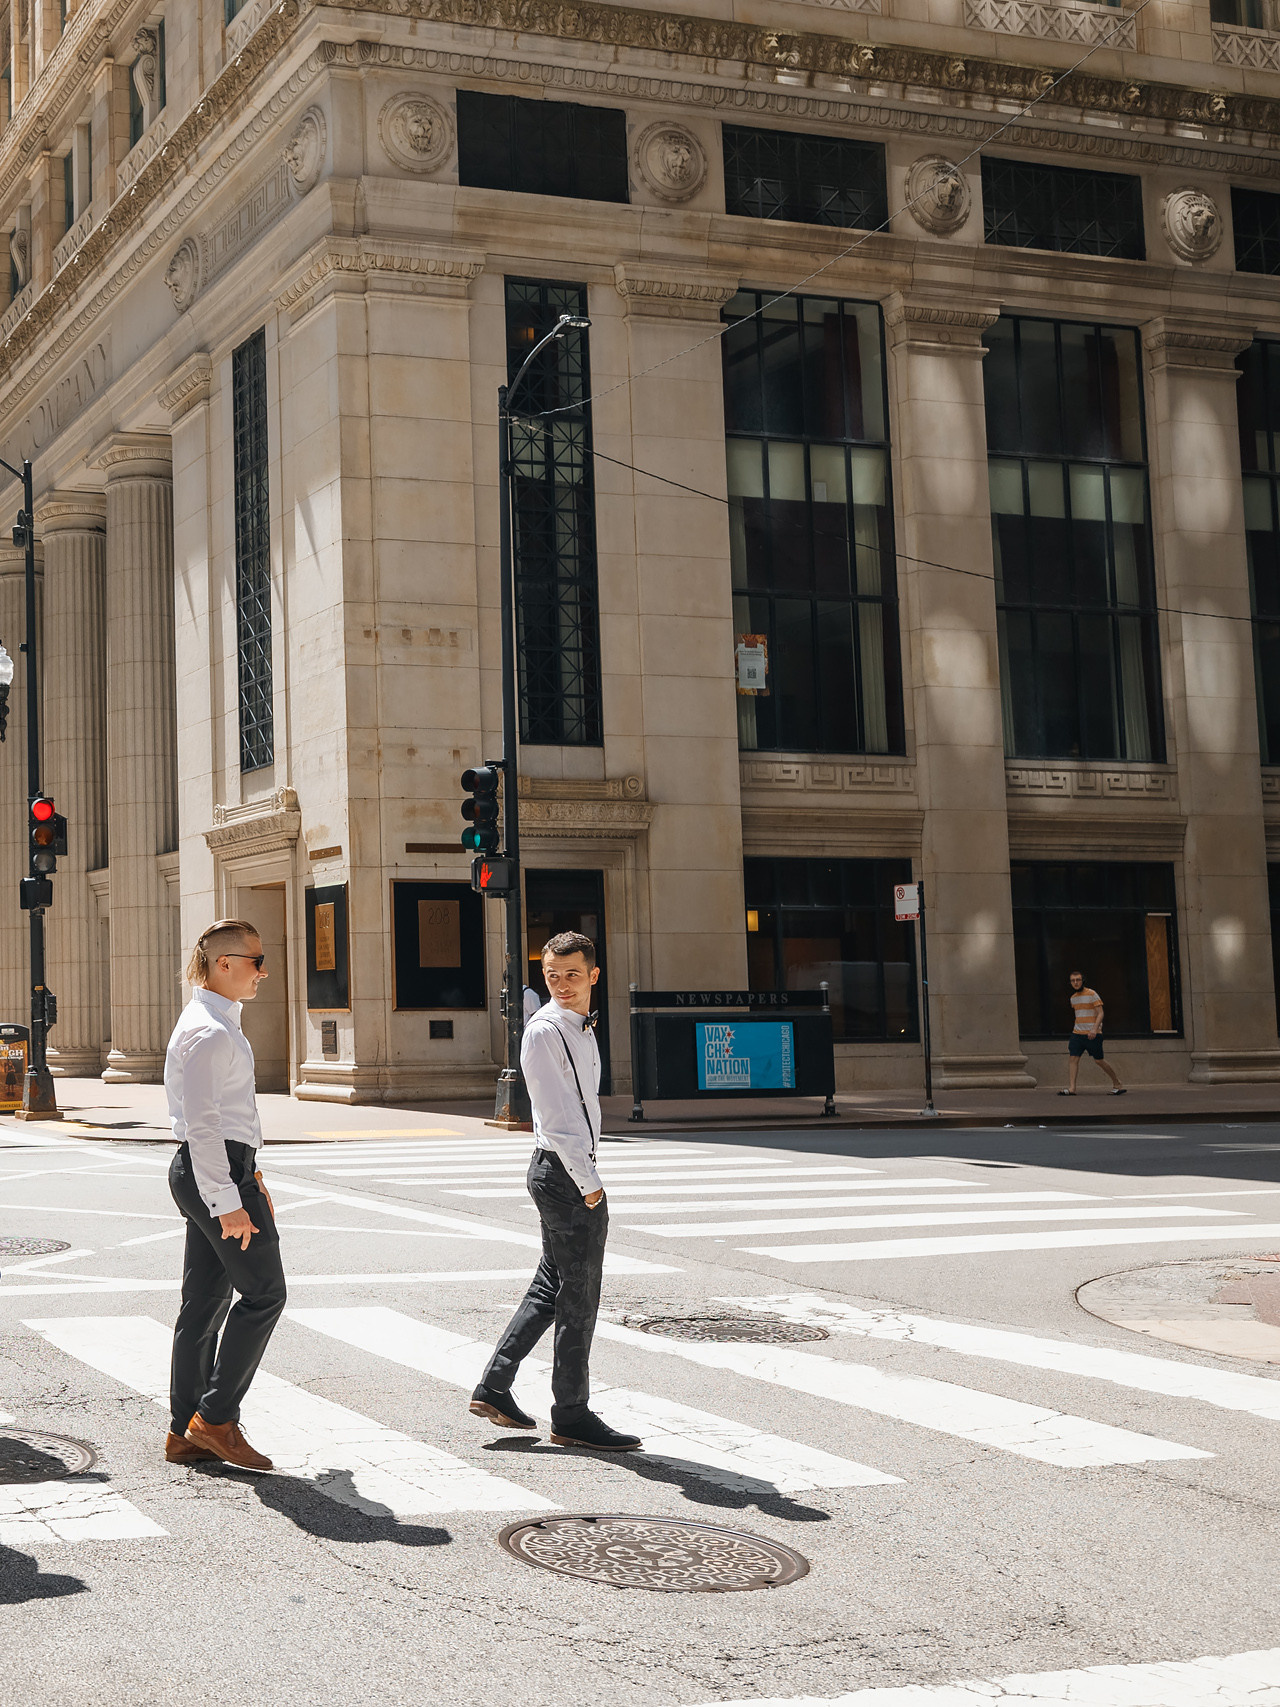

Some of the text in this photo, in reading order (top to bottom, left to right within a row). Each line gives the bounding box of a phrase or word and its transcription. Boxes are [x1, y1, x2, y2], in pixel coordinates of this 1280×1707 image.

[428, 907, 451, 925] 208
[676, 993, 789, 1005] NEWSPAPERS
[706, 1027, 728, 1042] VAX
[781, 1025, 791, 1088] #PROTECTCHICAGO
[706, 1059, 749, 1075] NATION
